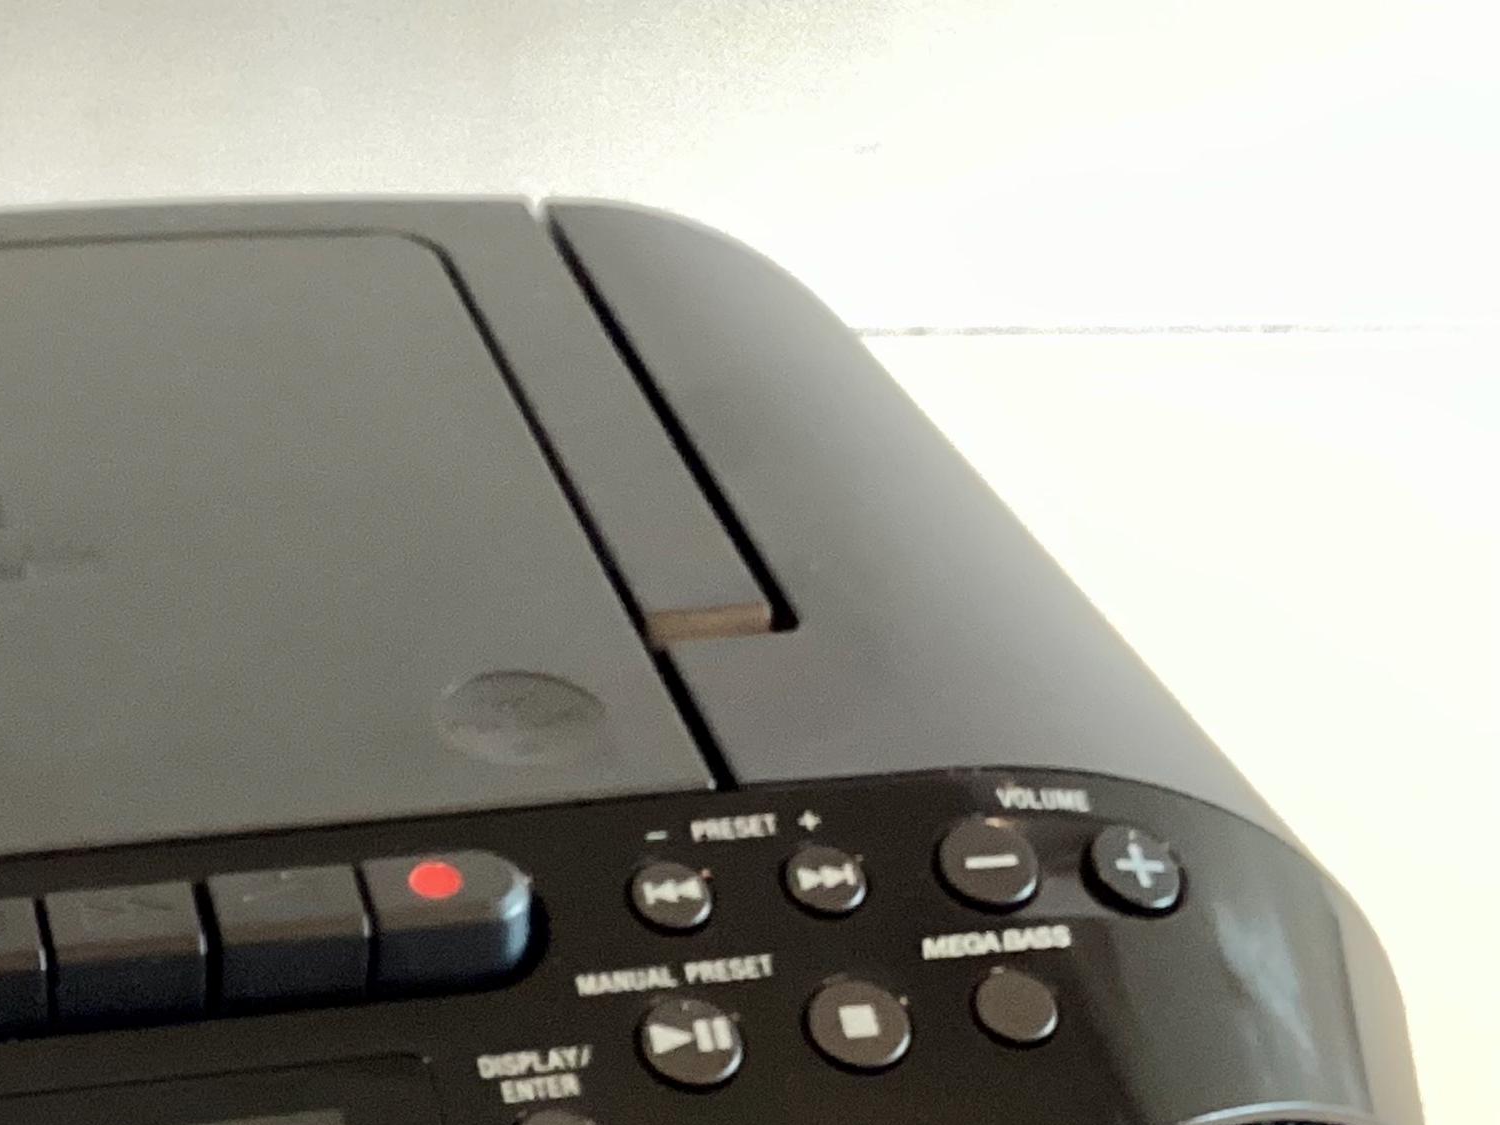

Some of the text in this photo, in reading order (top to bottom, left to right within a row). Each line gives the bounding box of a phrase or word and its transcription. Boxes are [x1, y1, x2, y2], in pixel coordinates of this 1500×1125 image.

[996, 786, 1091, 812] VOLUME
[690, 812, 777, 842] PRESET
[921, 924, 1072, 960] MEGA BASS
[575, 953, 773, 997] MANUAL PRESET
[476, 1044, 592, 1079] DISPLAY/
[501, 1073, 581, 1103] ENTER
